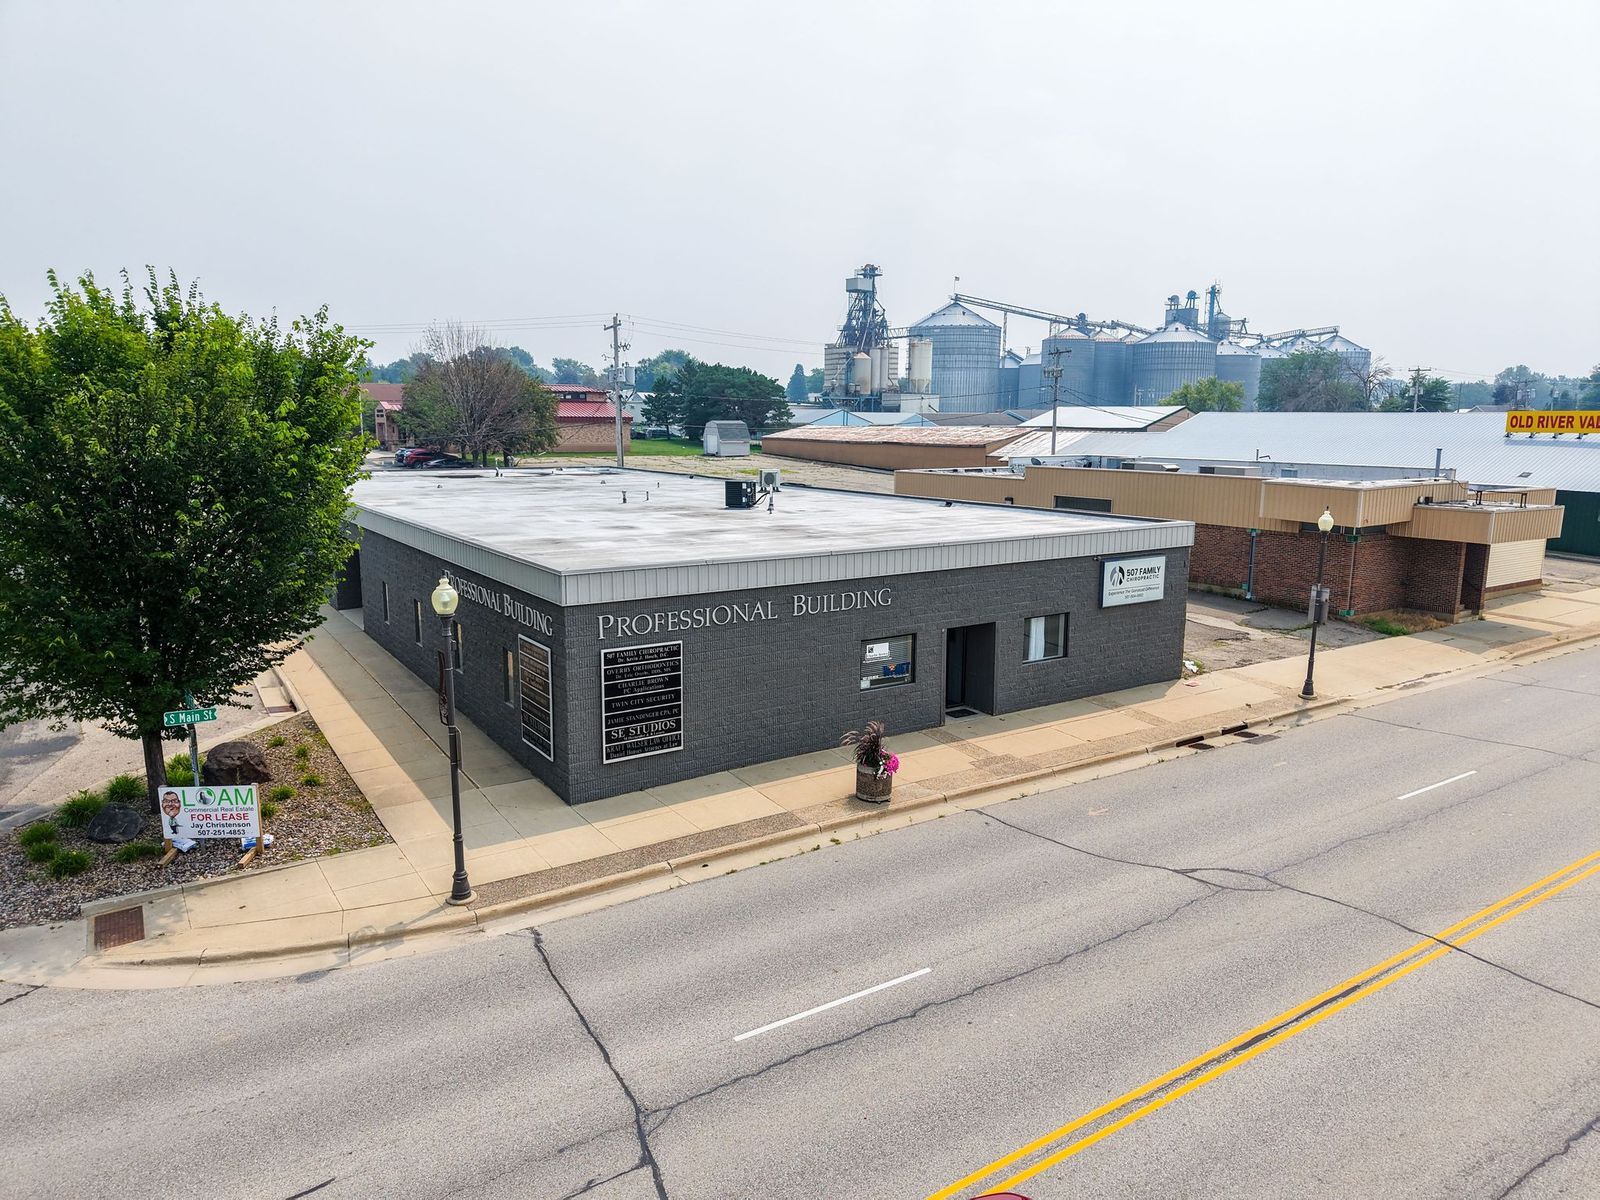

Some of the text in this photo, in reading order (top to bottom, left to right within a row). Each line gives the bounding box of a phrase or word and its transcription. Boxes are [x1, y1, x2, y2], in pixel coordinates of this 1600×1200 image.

[1510, 415, 1534, 428] OLD
[1537, 415, 1574, 428] RIVER
[1126, 566, 1161, 576] 507 FAMILY
[1126, 574, 1160, 582] CHIROPRACTIC
[503, 593, 552, 636] BUILDING
[597, 588, 892, 640] PROFESSIONAL BUILDING
[616, 650, 637, 658] FAMILY
[639, 645, 679, 655] CHIROPRACTIC
[633, 660, 679, 671] ORTHODONTICS
[633, 684, 664, 693] Applications
[646, 694, 675, 702] SECURITY
[170, 710, 212, 723] S Main St
[611, 729, 625, 739] SE
[629, 720, 676, 735] STUDIOS
[215, 812, 249, 820] LEASE
